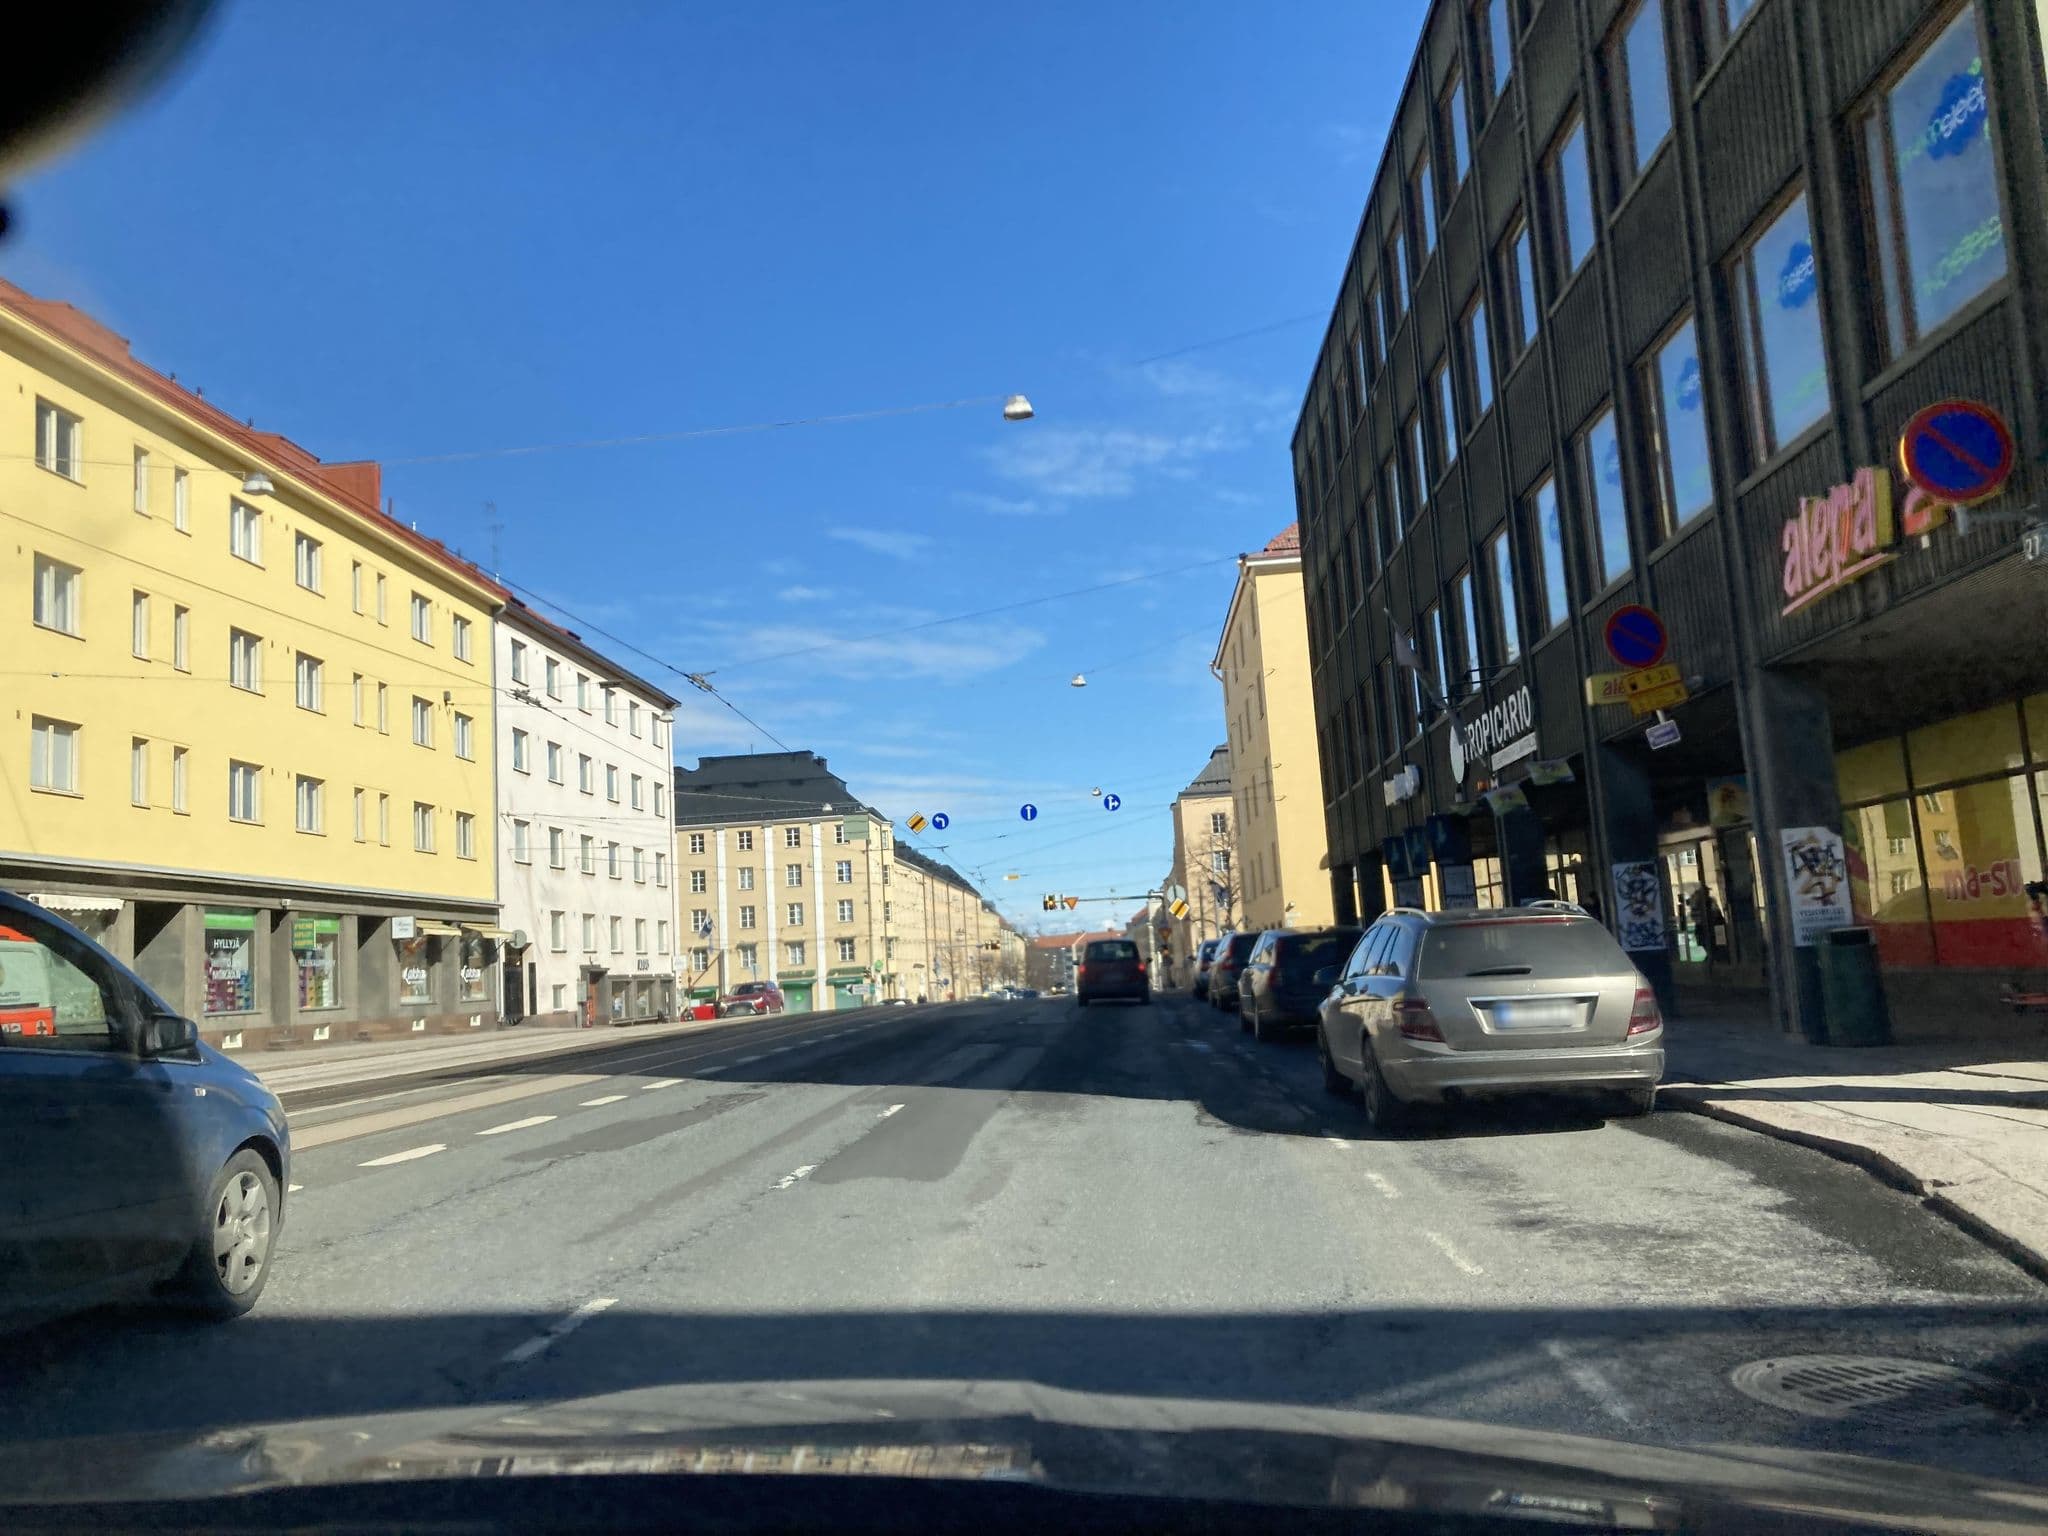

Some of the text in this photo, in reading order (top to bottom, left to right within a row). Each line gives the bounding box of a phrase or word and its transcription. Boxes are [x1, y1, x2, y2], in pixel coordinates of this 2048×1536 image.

[1782, 466, 1877, 598] alepa
[1463, 685, 1532, 764] TROPICARIO
[213, 937, 241, 949] HYLLYJÄ
